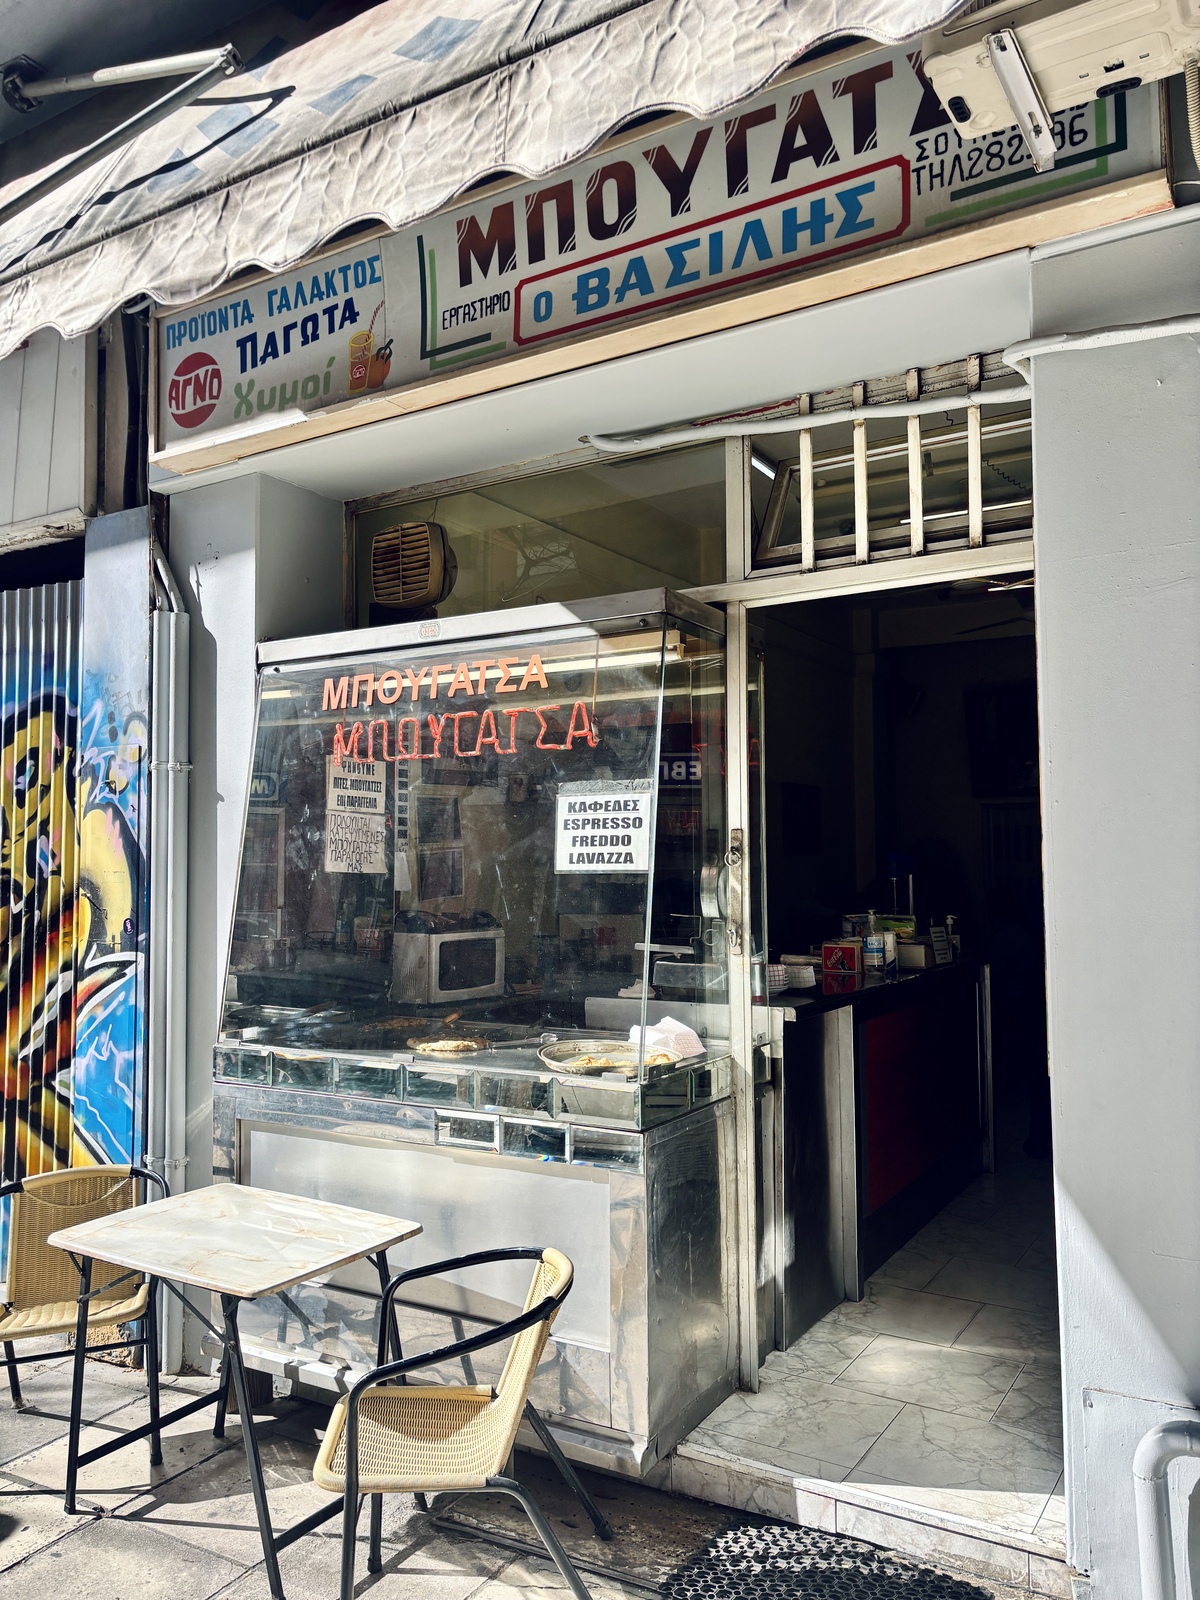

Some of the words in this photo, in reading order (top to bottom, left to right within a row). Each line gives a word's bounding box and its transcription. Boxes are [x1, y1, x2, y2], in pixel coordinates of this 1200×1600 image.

[533, 290, 553, 324] Ο
[572, 181, 877, 315] ΒΑΣΙΛΗΣ
[165, 299, 255, 351] ΠΡΟΪΟΝΤΑ
[267, 254, 383, 318] ΓΑΛΑΚΤΟΣ
[442, 291, 511, 331] ΕΡΓΑΣΤΗΡΙΟ
[236, 297, 361, 375] ΠΑΓΩΤΑ
[168, 367, 223, 411] ΑΓΝΟ
[233, 356, 336, 420] Χυμοί
[321, 654, 549, 711] ΜΠΟΥΓΑΤΣΑ
[333, 700, 598, 767] ΜΠΟΥΓΑΤΣΑ
[341, 760, 376, 776] ΨΗΝΟΥΜΕ
[563, 816, 643, 831] ESPRESSO
[567, 799, 640, 813] ΚΑΦΕΔΕΣ
[568, 852, 634, 865] LAVAZZA
[571, 834, 632, 848] FREDDO
